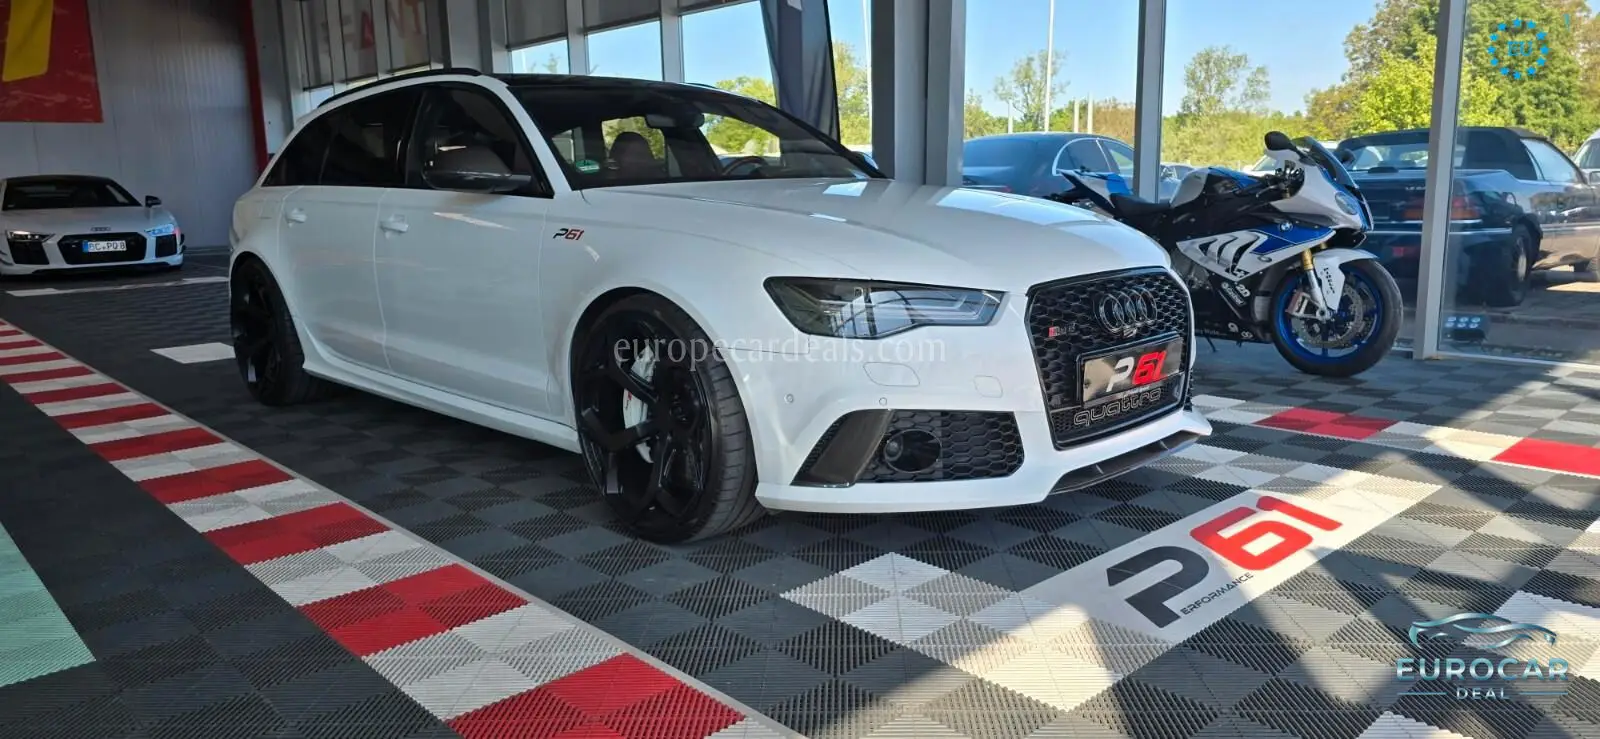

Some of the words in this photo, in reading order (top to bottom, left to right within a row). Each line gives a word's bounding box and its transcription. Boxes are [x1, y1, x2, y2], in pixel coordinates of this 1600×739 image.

[553, 228, 584, 240] P61
[1106, 351, 1167, 392] P61
[1073, 387, 1162, 427] quattro
[1106, 495, 1343, 629] P61
